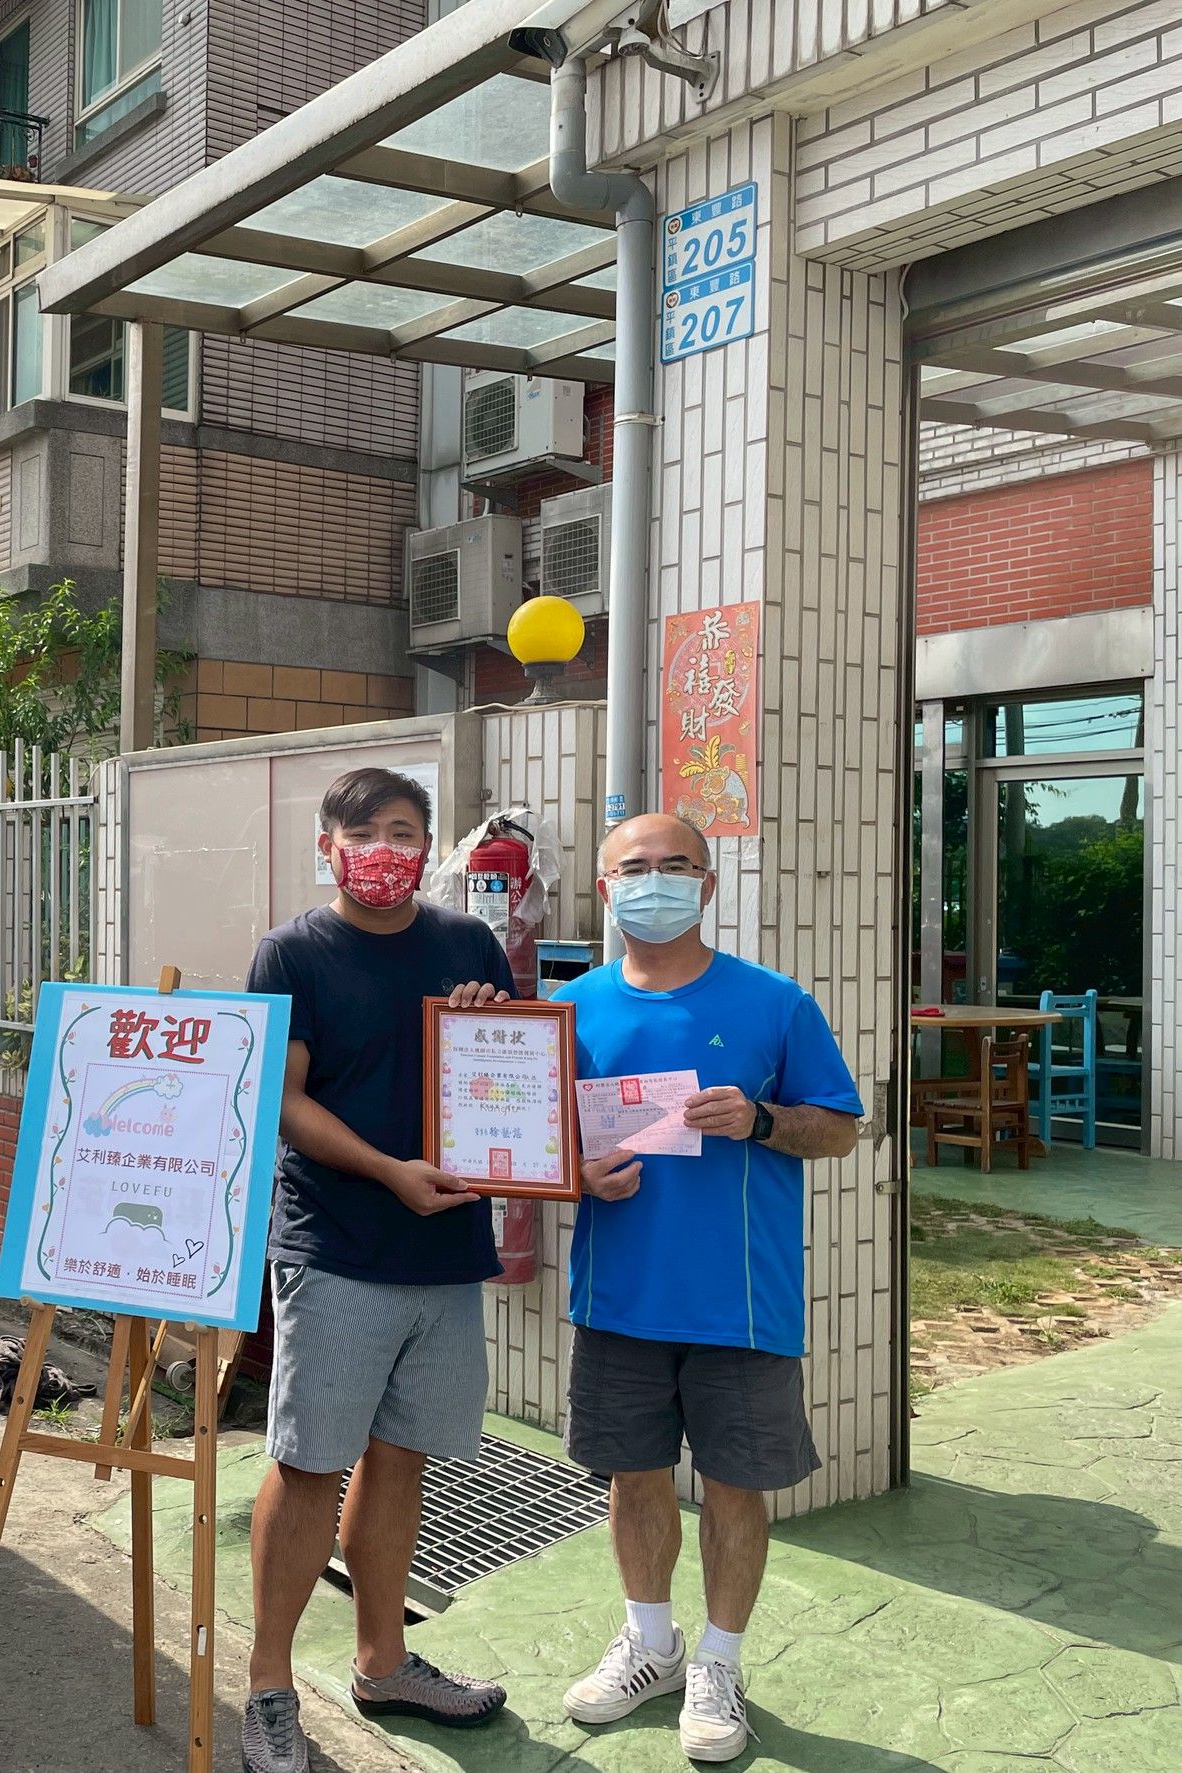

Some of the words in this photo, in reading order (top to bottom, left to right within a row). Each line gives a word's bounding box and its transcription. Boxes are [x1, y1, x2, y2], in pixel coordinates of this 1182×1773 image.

[691, 194, 743, 225] 東豐路
[681, 218, 748, 276] 205
[689, 270, 740, 300] 東豐路
[678, 295, 746, 351] 207
[107, 1009, 212, 1065] 歡迎
[474, 1027, 527, 1046] 感謝狀
[101, 1113, 174, 1137] Welcome
[76, 1147, 216, 1177] 艾利臻企業有限公司
[111, 1180, 173, 1198] LOVEFU
